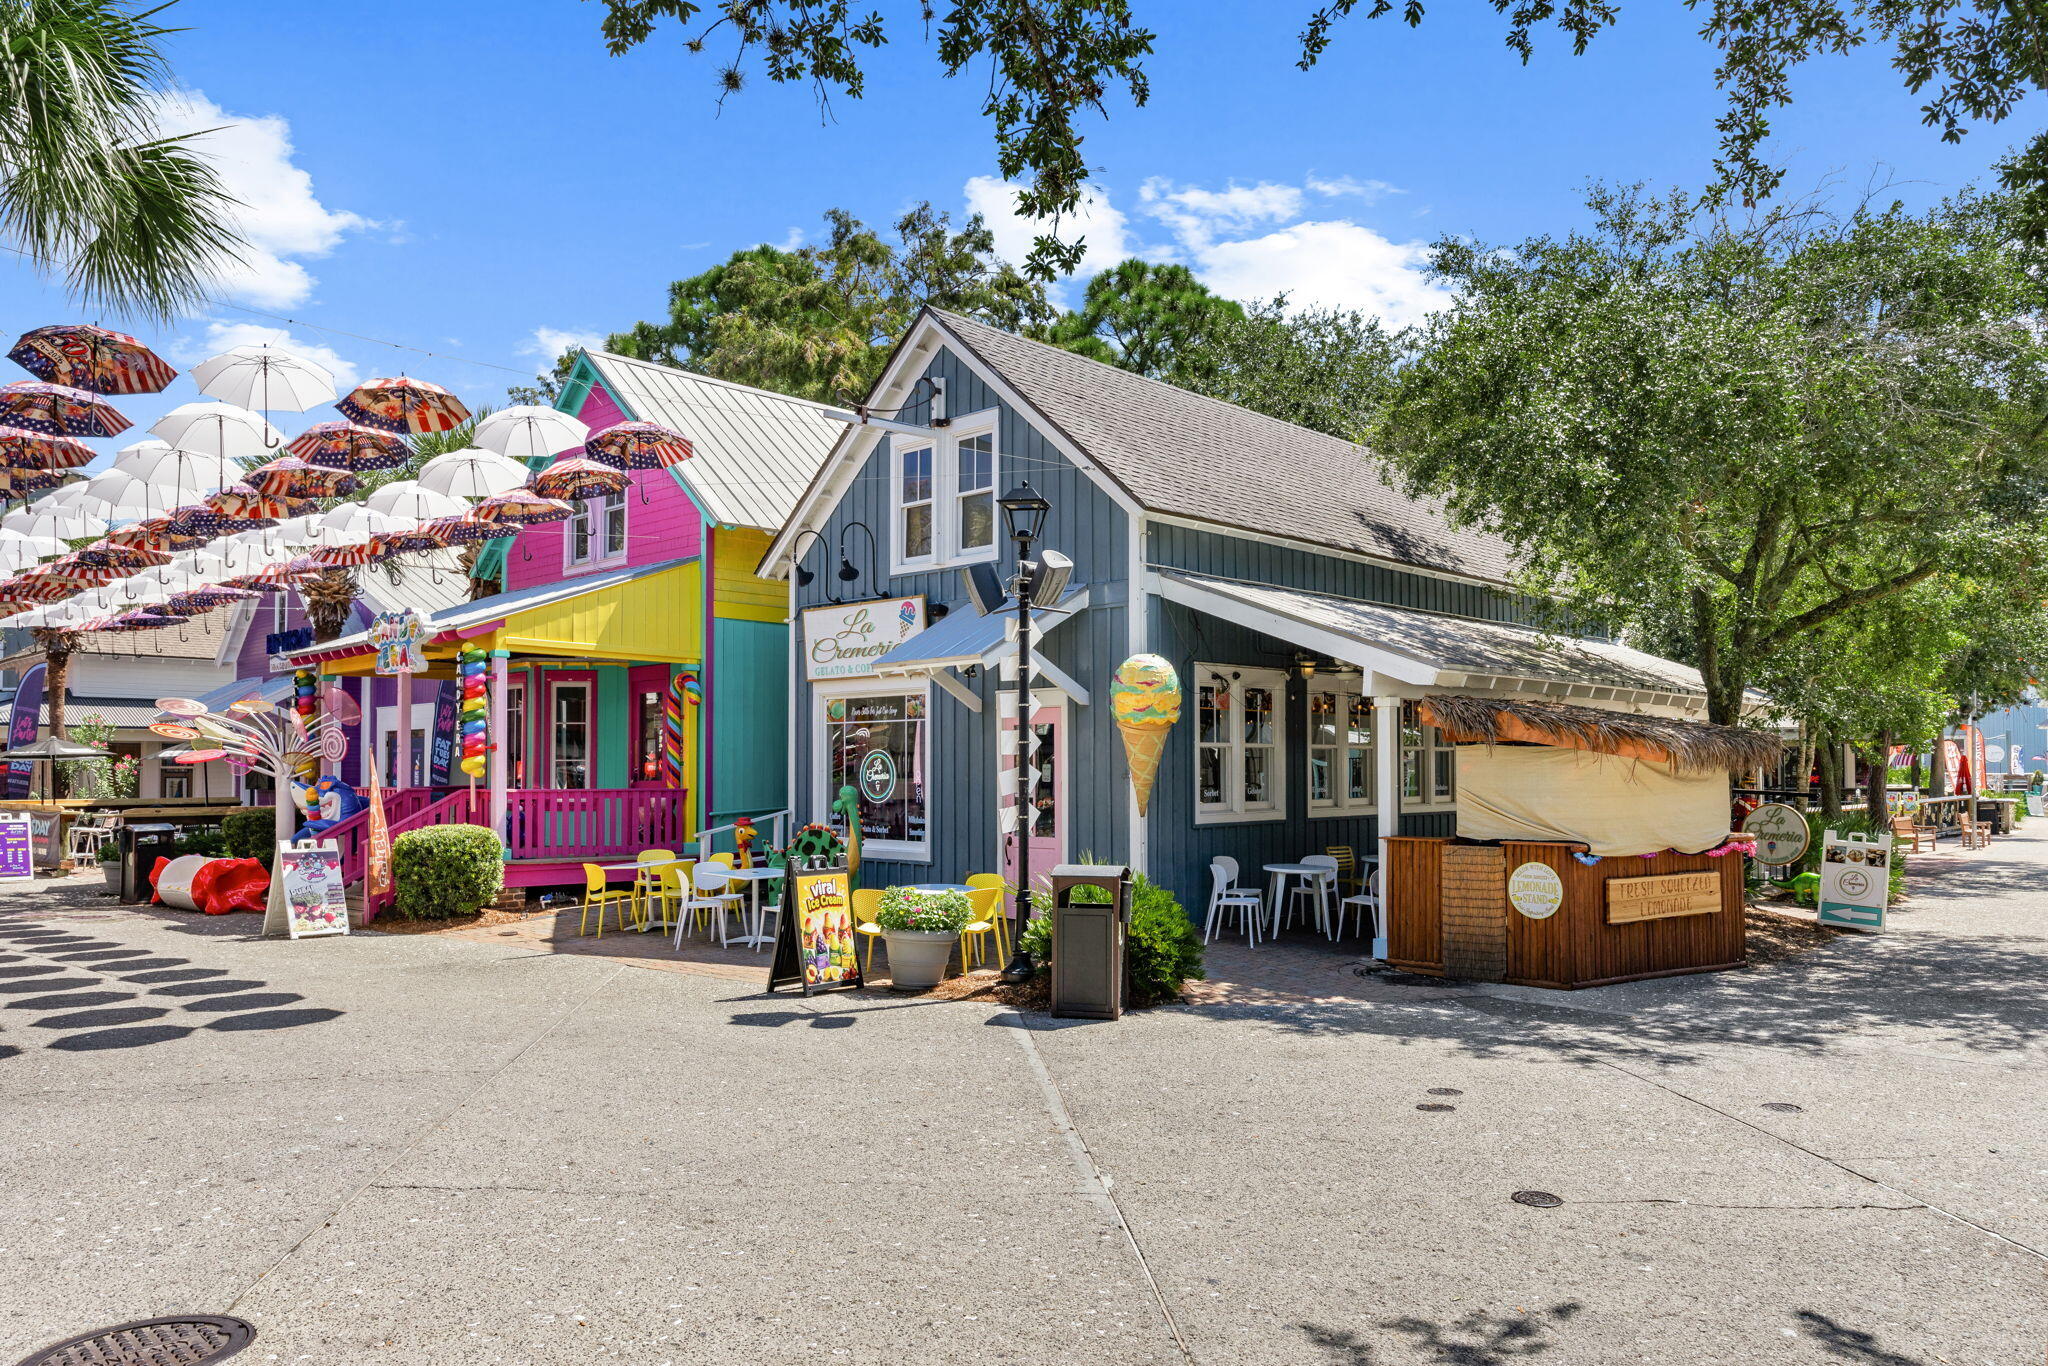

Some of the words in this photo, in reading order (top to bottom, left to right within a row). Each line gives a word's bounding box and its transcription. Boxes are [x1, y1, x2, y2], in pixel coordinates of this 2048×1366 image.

[836, 608, 875, 642] La
[811, 637, 903, 664] Cremeri
[814, 665, 846, 677] GELATO
[847, 665, 854, 674] &
[435, 737, 452, 751] FAT
[10, 761, 32, 772] DAY
[433, 755, 449, 768] DAY
[1203, 789, 1219, 798] Sorbet
[1760, 807, 1786, 831] La
[1511, 880, 1559, 896] LEMONADE
[1620, 881, 1654, 899] FRESH
[1660, 875, 1711, 894] SQUEEZED
[806, 898, 820, 913] Ice
[820, 894, 843, 909] Cream
[1522, 893, 1549, 905] STAND
[1640, 896, 1693, 917] LEMONADE
